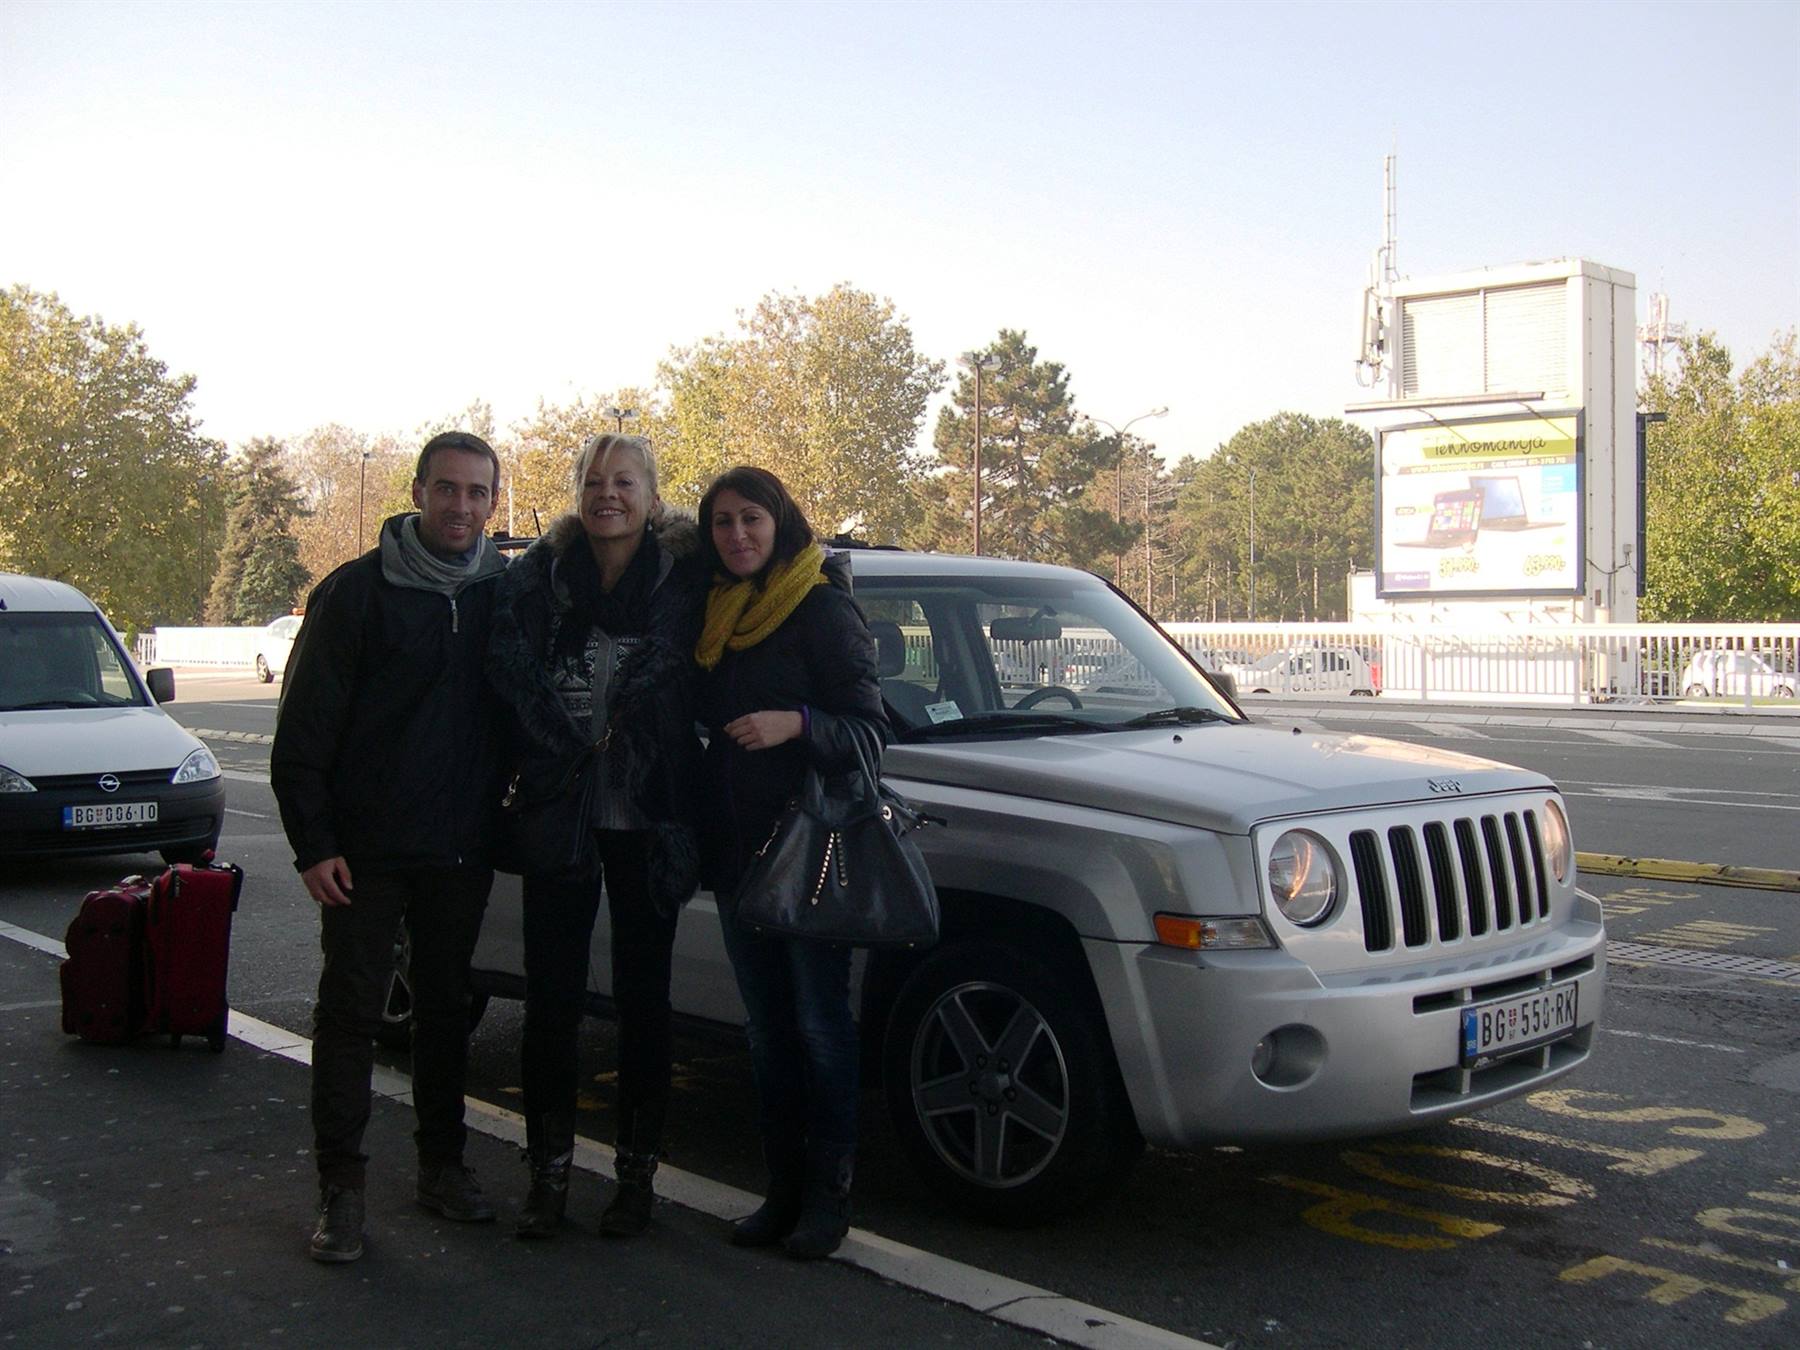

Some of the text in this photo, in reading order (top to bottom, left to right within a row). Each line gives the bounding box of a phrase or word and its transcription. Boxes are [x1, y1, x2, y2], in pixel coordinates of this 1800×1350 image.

[1427, 779, 1463, 793] Jeep
[75, 807, 94, 824] BG
[1482, 1008, 1505, 1047] BG
